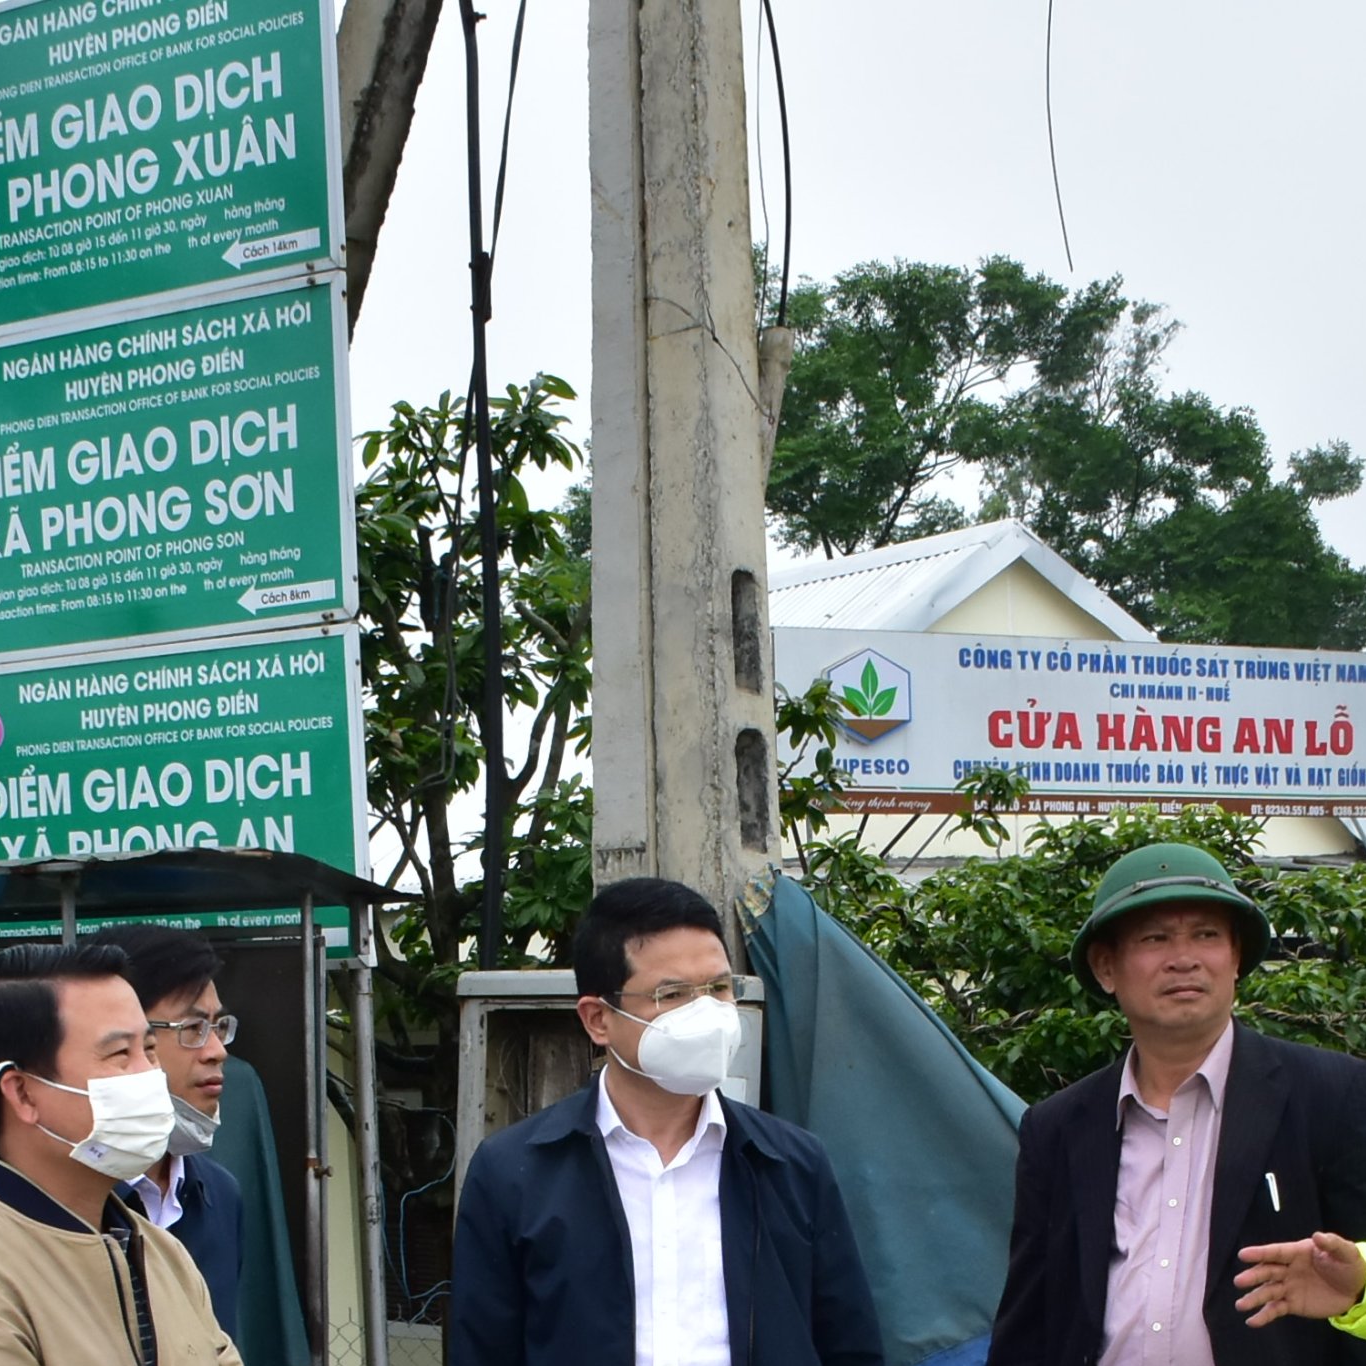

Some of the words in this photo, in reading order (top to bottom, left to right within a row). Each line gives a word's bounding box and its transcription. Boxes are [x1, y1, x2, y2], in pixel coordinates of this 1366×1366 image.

[43, 3, 97, 34] HÀNG
[49, 32, 107, 66] HUYỆN
[112, 13, 180, 49] PHONG
[51, 84, 162, 149] GIAO
[175, 51, 282, 122] DỊCH
[8, 147, 159, 223] PHONG
[172, 113, 296, 185] XUÂN
[86, 209, 122, 230] POINT
[125, 205, 141, 221] OF
[146, 193, 193, 217] PHONG
[196, 184, 233, 206] XUAN
[3, 352, 55, 381] NGÂN
[60, 342, 112, 370] HÀNG
[117, 328, 176, 358] CHÍNH
[182, 317, 236, 346] SÁCH
[276, 300, 311, 328] HỘI
[0, 419, 34, 436] PHONG
[37, 415, 59, 429] DIEN
[61, 401, 126, 425] TRANSACTION
[128, 396, 162, 412] OFFICE
[165, 391, 179, 405] OF
[181, 387, 208, 402] BANK
[212, 383, 232, 396] FOR
[234, 376, 272, 392] SOCIAL
[275, 366, 320, 385] POLICIES
[65, 371, 123, 402] HUYỆN
[128, 358, 195, 390] PHONG
[67, 426, 177, 484] GIAO
[190, 403, 298, 465] DỊCH
[41, 485, 191, 550] PHONG
[204, 468, 295, 525] SƠN
[20, 554, 102, 578] TRANSACTION
[106, 547, 142, 565] POINT
[145, 543, 162, 559] OF
[166, 536, 213, 556] PHONG
[216, 531, 245, 547] SON
[261, 591, 287, 605] Cách
[290, 588, 311, 601] 8km
[19, 678, 71, 704] NGÂN
[76, 673, 128, 698] HÀNG
[134, 666, 192, 692] CHÍNH
[197, 660, 251, 685] SÁCH
[289, 650, 325, 677] HỘI
[959, 642, 1012, 669] CÔNG
[1017, 650, 1041, 671] TY
[1047, 641, 1071, 672] CỔ
[1077, 644, 1126, 674] PHẦN
[1131, 648, 1192, 677] THUỐC
[1196, 653, 1229, 679] SÁT
[1234, 654, 1290, 681] TRÙNG
[1294, 658, 1331, 687] VIỆT
[81, 703, 138, 730] HUYỆN
[143, 698, 211, 724] PHONG
[1110, 683, 1134, 699] CHI
[1138, 681, 1183, 700] NHÁNH
[1206, 681, 1230, 702] HUẾ
[16, 743, 49, 757] PHONG
[53, 741, 74, 753] DIEN
[76, 734, 142, 751] TRANSACTION
[144, 731, 178, 745] OFFICE
[181, 729, 194, 742] OF
[197, 726, 223, 740] BANK
[226, 723, 246, 737] FOR
[248, 720, 286, 736] SOCIAL
[288, 716, 333, 732] POLICIES
[988, 698, 1082, 750] CỬA
[1096, 705, 1222, 753] HÀNG
[1233, 718, 1294, 754] AN
[1305, 704, 1353, 756] LỖ
[83, 762, 192, 813] GIAO
[205, 751, 311, 807] DỊCH
[1055, 762, 1100, 783] DOANH
[1107, 757, 1150, 783] THUỐC
[1191, 762, 1207, 787] VỆ
[1215, 763, 1248, 788] THỰC
[1255, 763, 1279, 789] VẬT
[1285, 762, 1301, 786] VÀ
[1308, 767, 1332, 790] HẠT
[236, 815, 294, 853] AN
